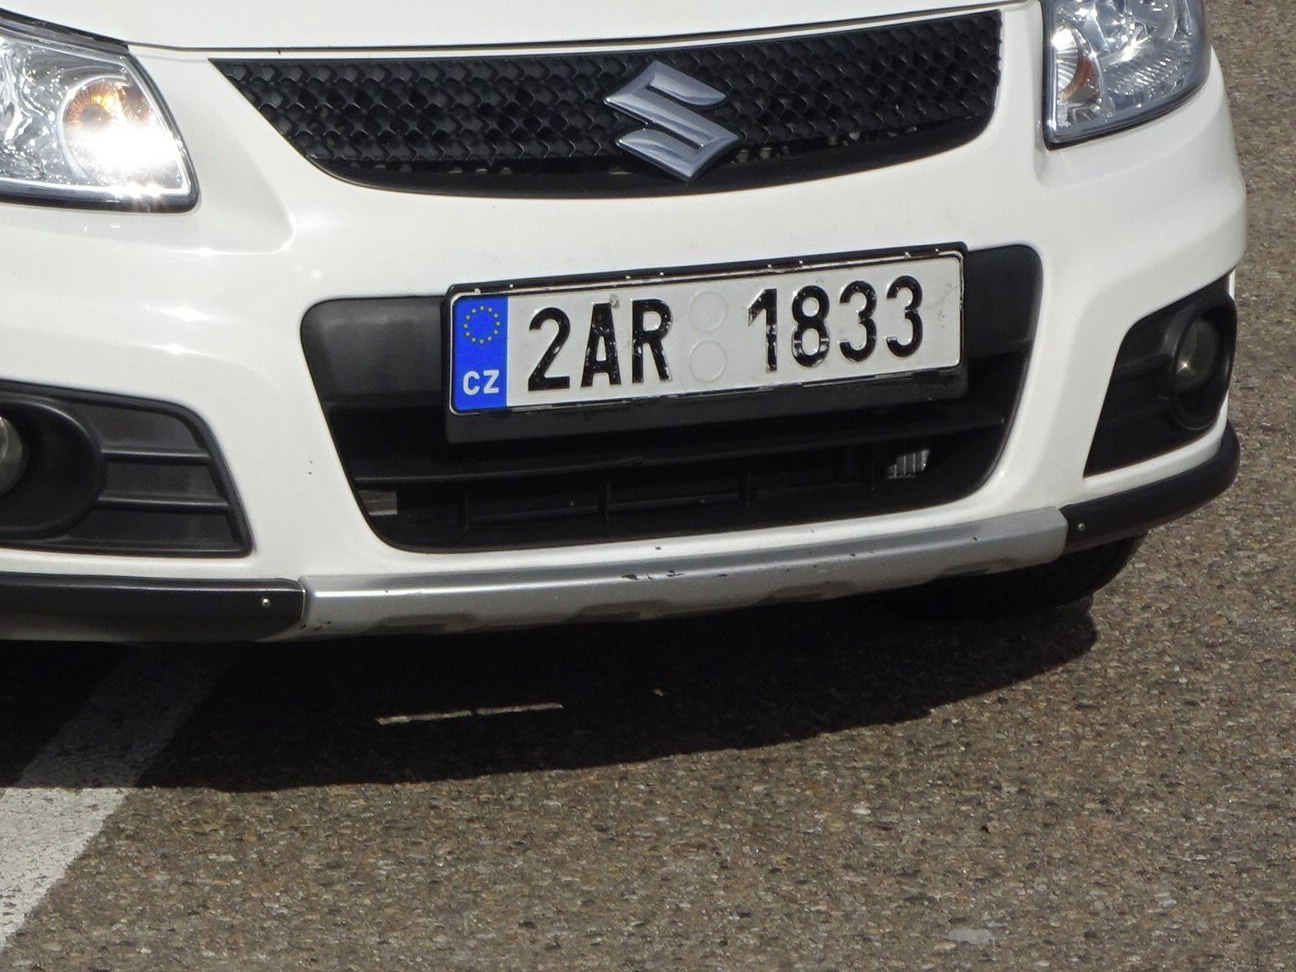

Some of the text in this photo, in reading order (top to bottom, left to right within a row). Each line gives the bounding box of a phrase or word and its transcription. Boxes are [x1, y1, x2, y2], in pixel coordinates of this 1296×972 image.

[527, 275, 924, 392] 2AR 1833
[462, 369, 500, 396] CZ
